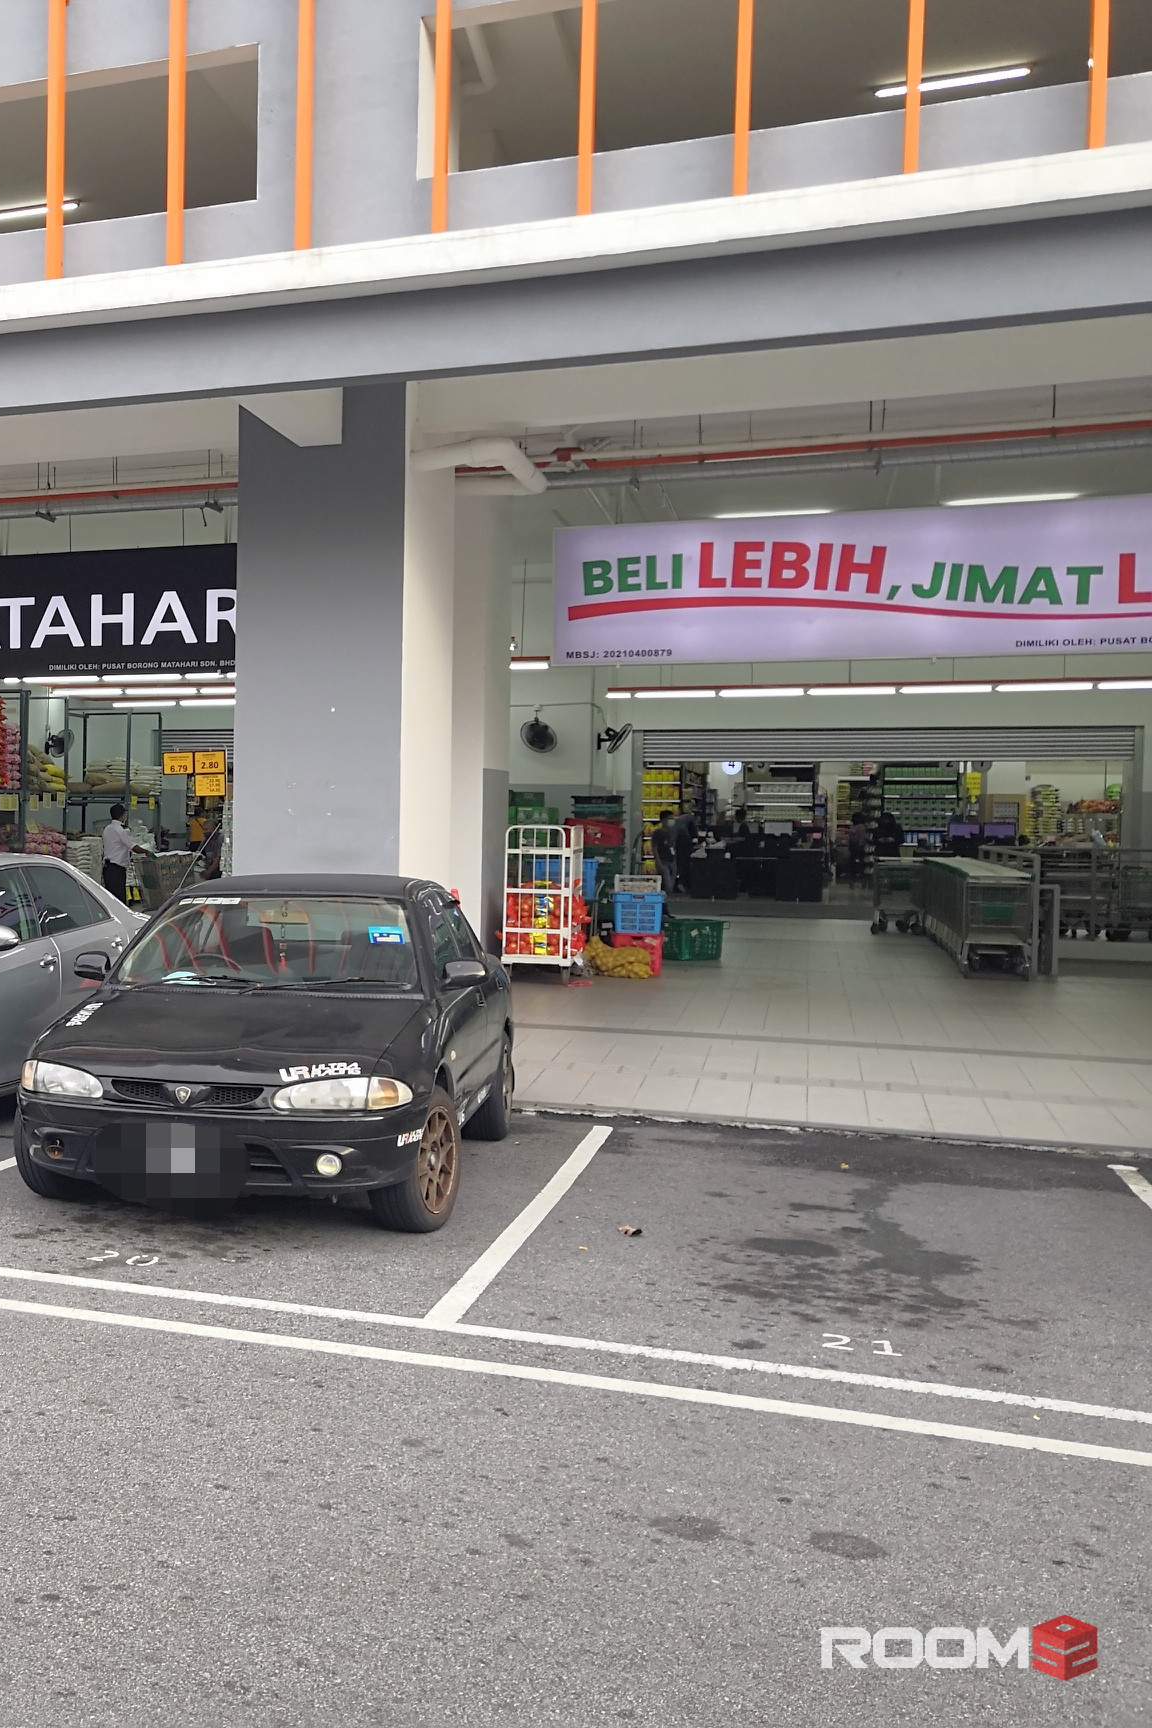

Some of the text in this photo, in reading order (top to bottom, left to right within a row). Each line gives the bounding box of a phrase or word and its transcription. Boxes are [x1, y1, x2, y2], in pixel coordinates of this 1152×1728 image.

[582, 541, 1152, 605] BELI LEBIH, JIMAT L
[1015, 639, 1059, 647] DIMILIKI
[1062, 638, 1096, 647] OLEH:
[1100, 637, 1137, 645] PUSAT
[566, 649, 673, 659] MBSJ: 20210400879
[78, 663, 100, 671] OLEH:
[170, 764, 188, 773] 6.79
[200, 761, 219, 770] 2.80
[86, 1249, 160, 1267] 20
[821, 1332, 903, 1357] 21
